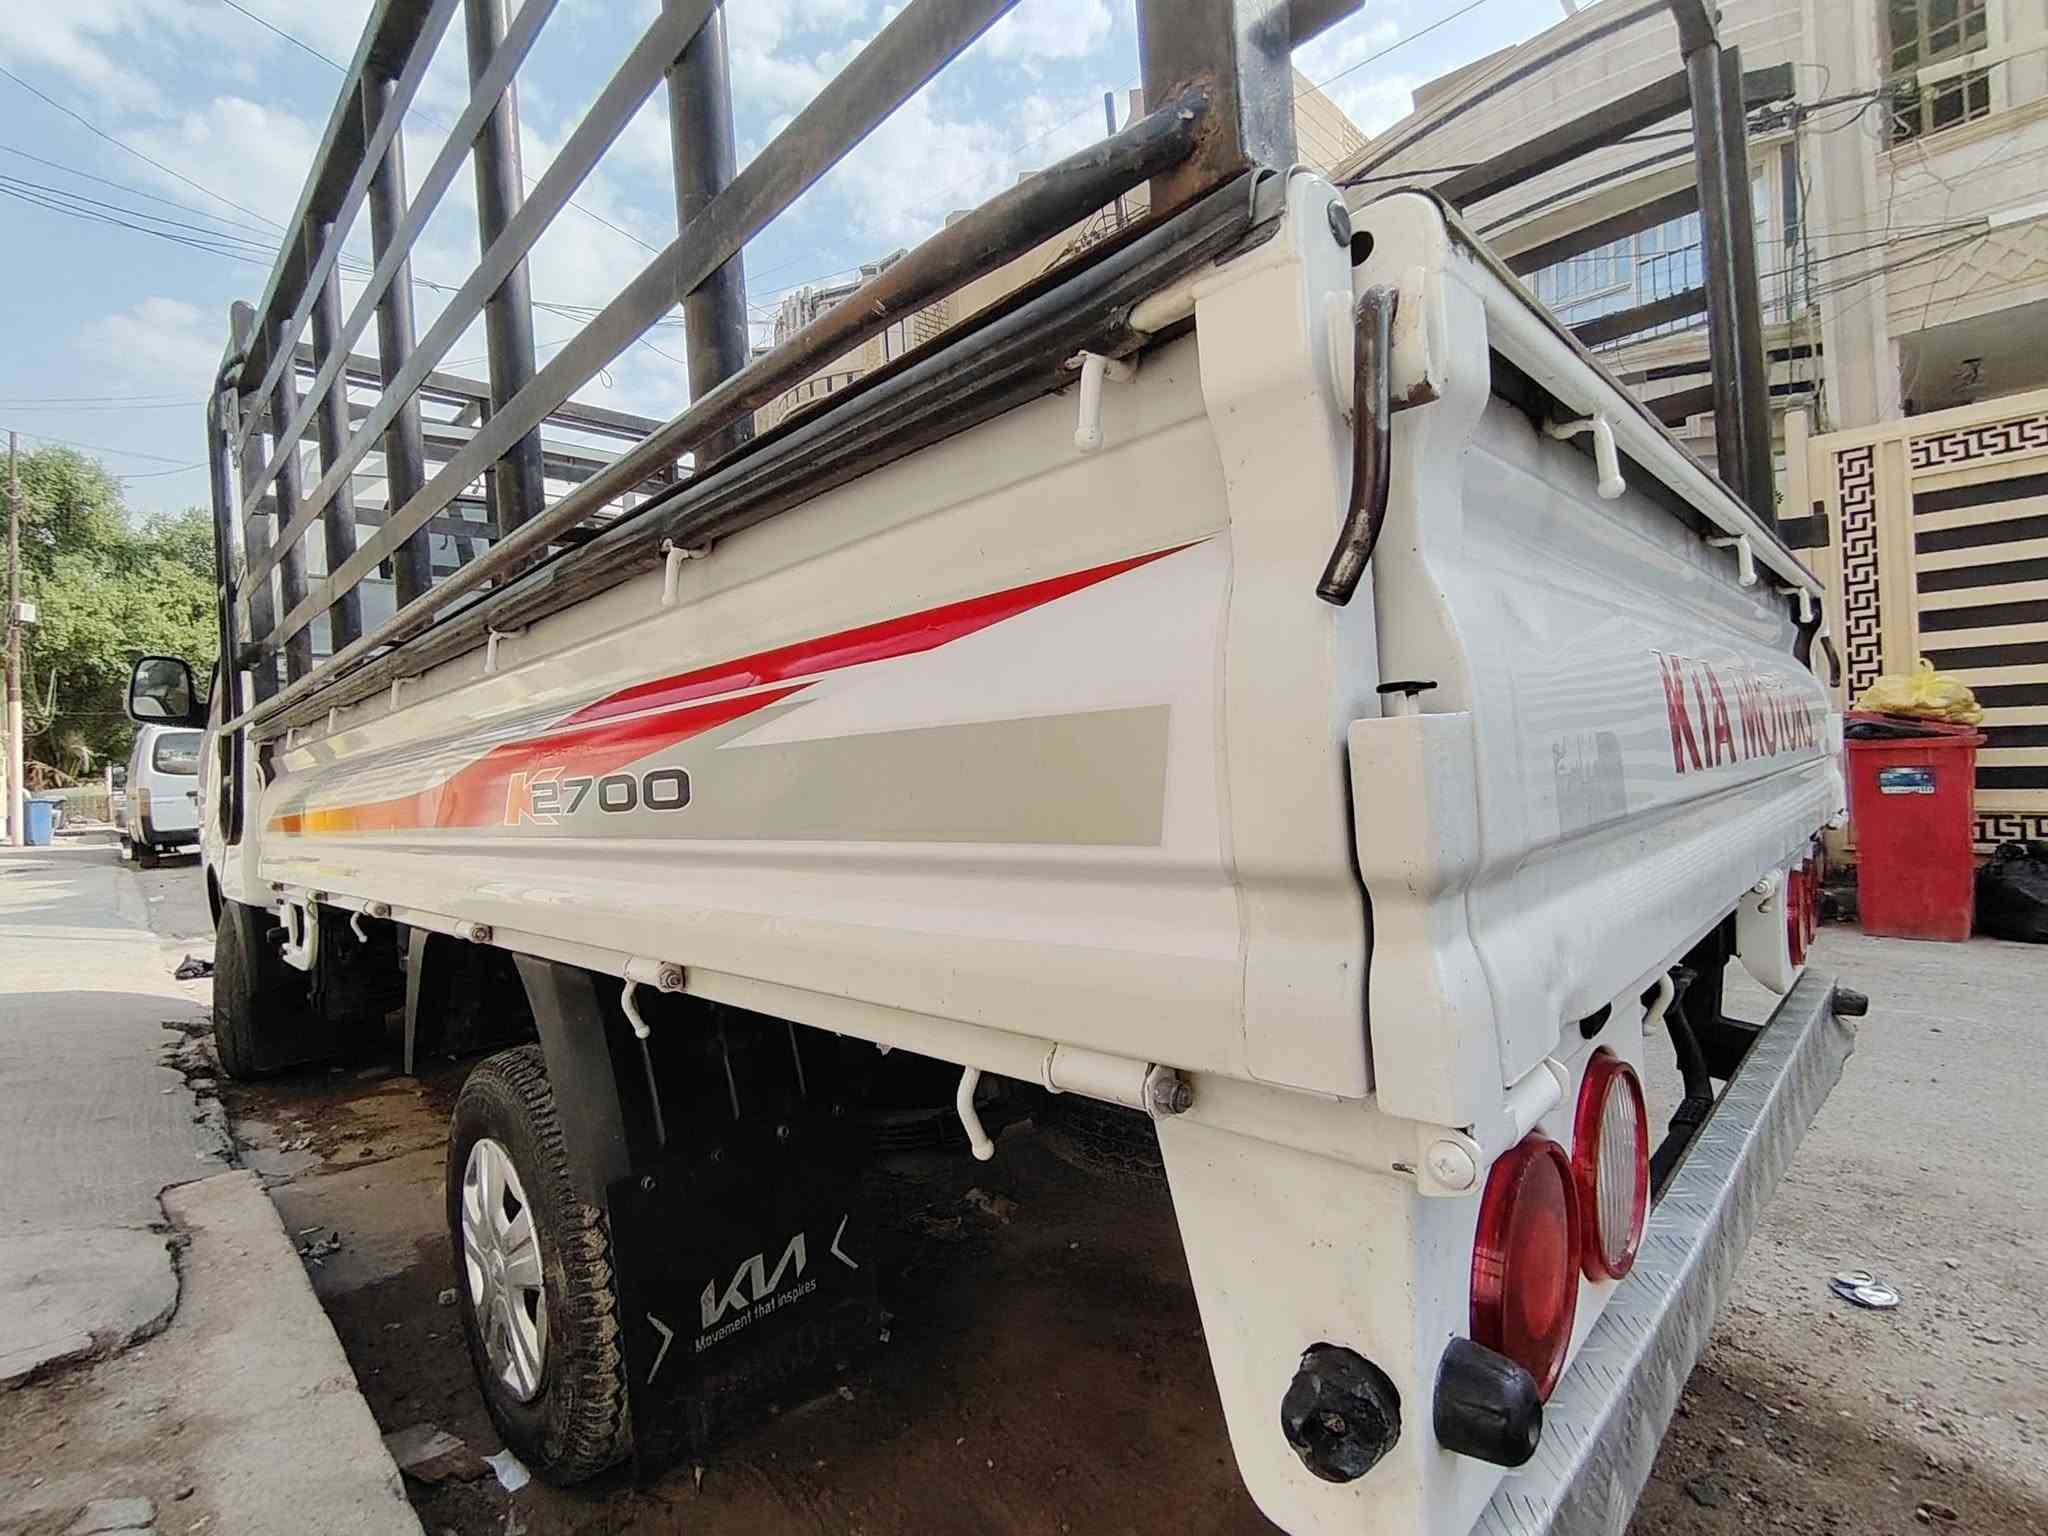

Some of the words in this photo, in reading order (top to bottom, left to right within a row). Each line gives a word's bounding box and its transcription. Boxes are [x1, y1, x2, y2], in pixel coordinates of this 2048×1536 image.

[1656, 652, 1738, 775] KIA
[504, 766, 691, 826] K2700
[695, 1310, 752, 1352] Movement
[754, 1297, 776, 1320] that
[777, 1278, 817, 1307] inspires
